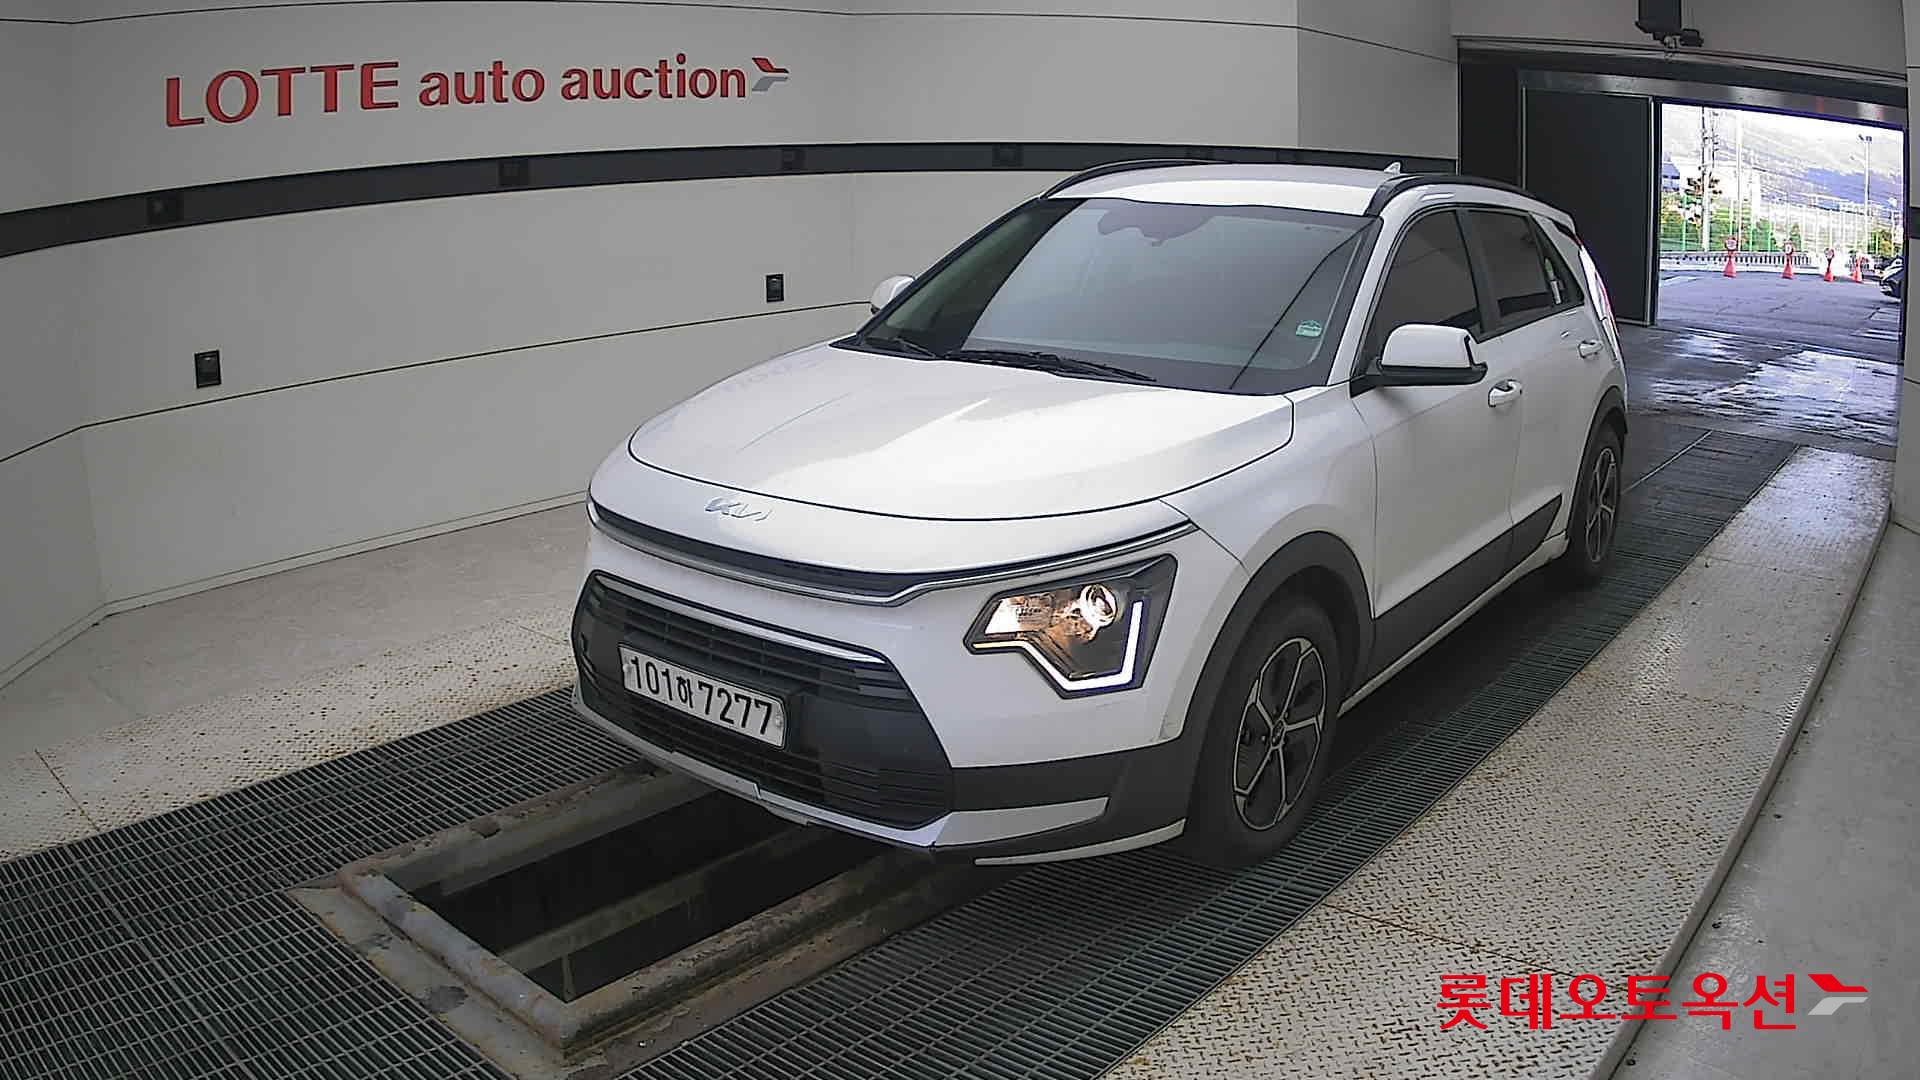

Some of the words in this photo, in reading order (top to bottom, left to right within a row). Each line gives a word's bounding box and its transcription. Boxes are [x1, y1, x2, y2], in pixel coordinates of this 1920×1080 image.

[165, 60, 400, 127] LOTTE
[418, 60, 546, 107] auto
[560, 53, 747, 100] auction
